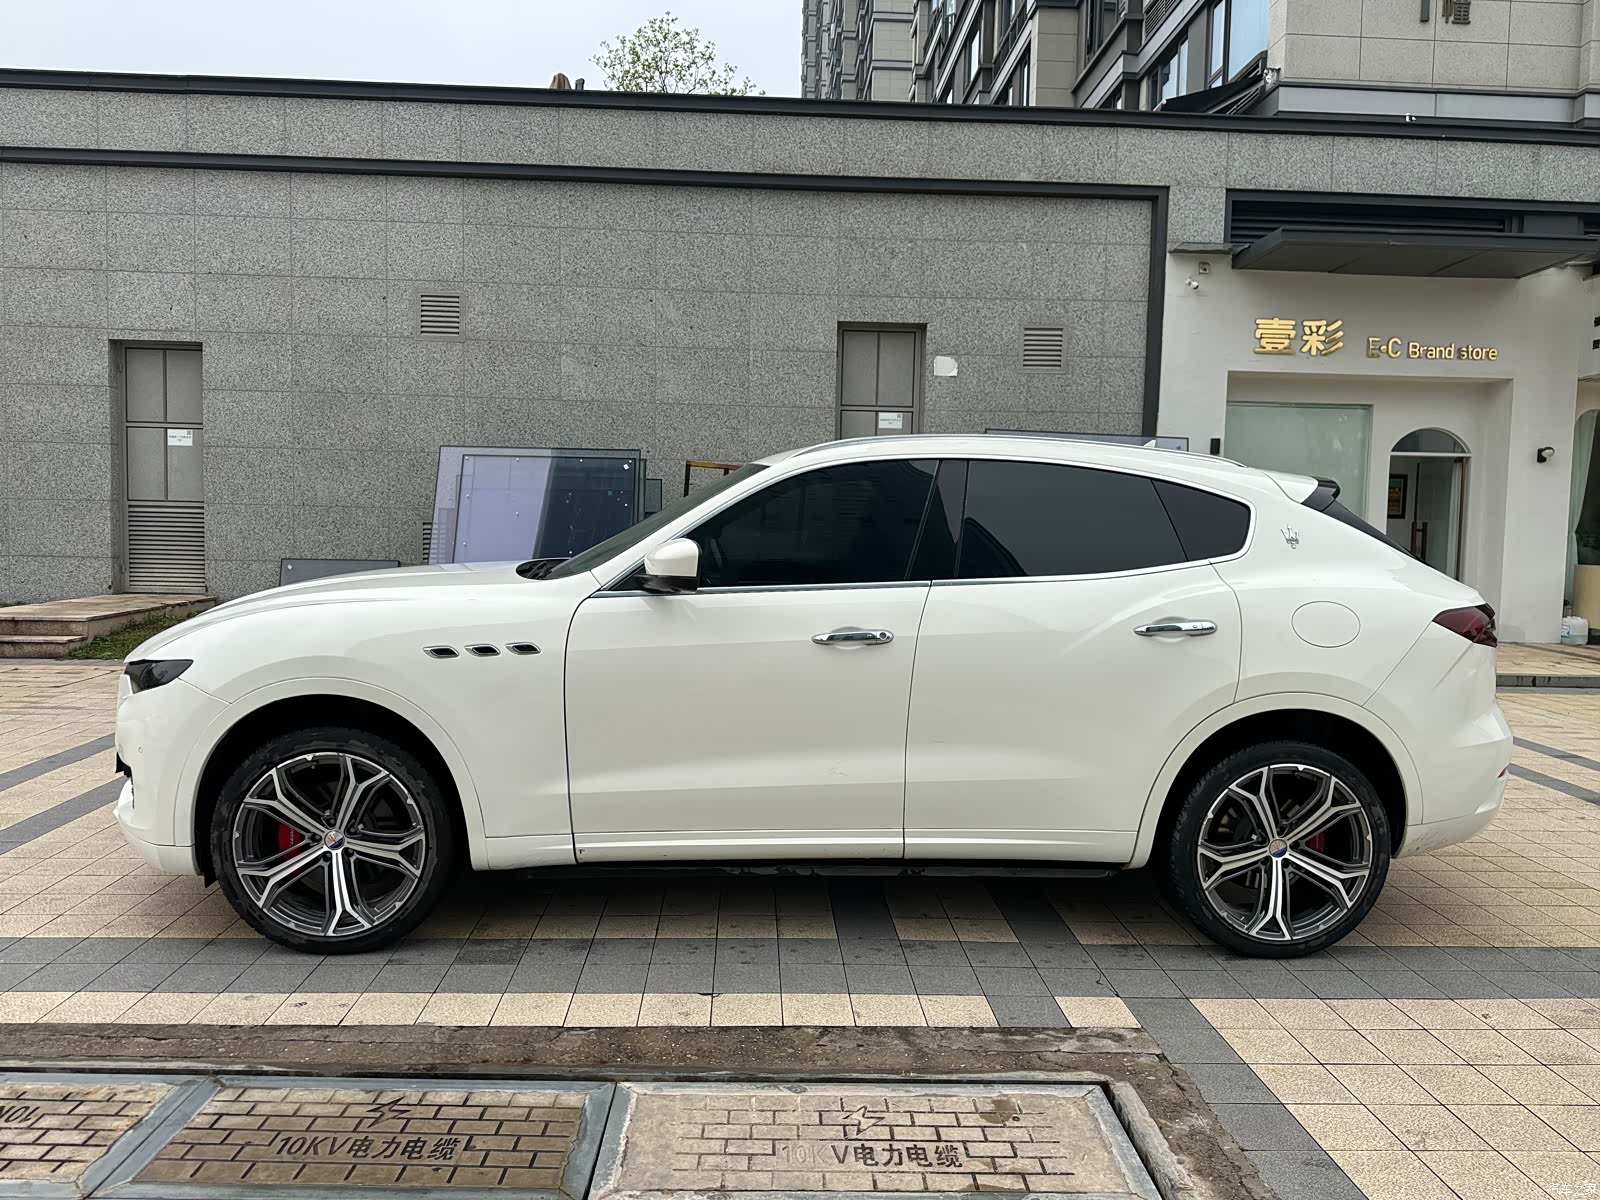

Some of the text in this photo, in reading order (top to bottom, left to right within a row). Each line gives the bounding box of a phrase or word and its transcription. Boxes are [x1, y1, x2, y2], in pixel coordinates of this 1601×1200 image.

[1254, 317, 1345, 356] 壹彩
[1408, 342, 1455, 360] Brand
[1457, 344, 1498, 361] store
[275, 1136, 461, 1161] 10KV电力电缆
[781, 1142, 963, 1168] 10KV电力电缆
